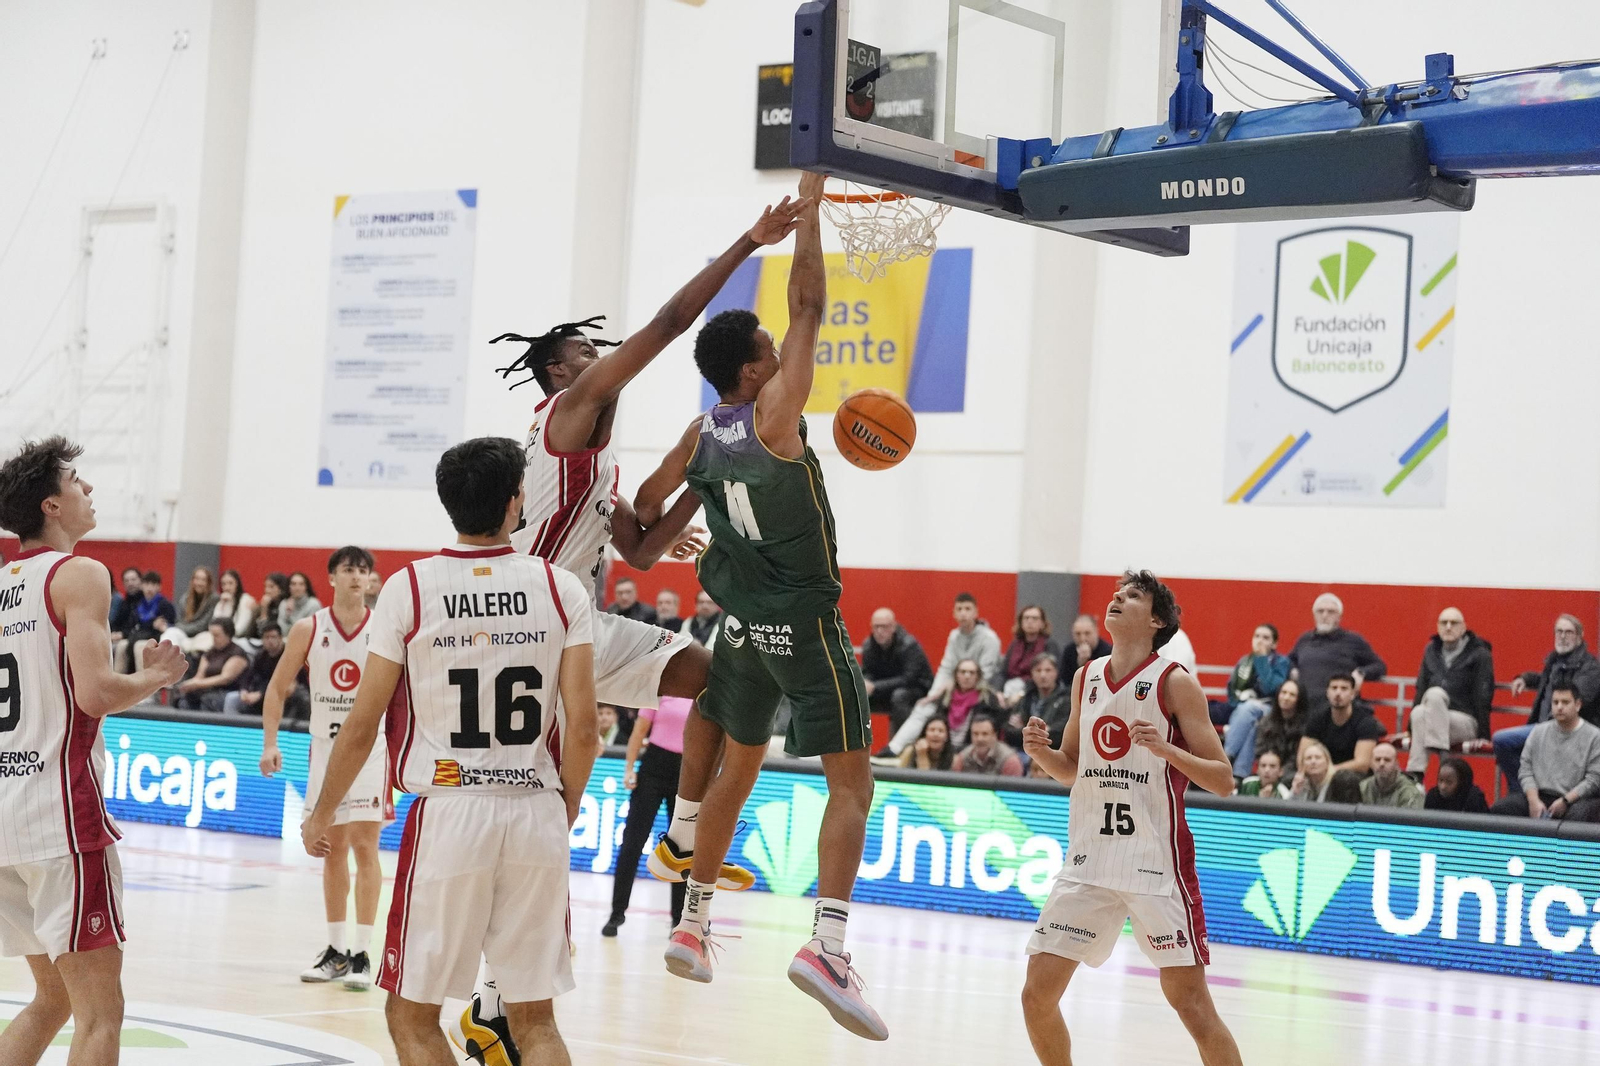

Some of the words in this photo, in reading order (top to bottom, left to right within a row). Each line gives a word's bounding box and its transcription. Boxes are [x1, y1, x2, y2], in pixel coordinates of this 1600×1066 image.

[762, 107, 792, 126] LOC
[1161, 177, 1245, 200] MONDO
[349, 214, 369, 226] LOS
[372, 212, 434, 224] PRINCIPIOS
[1293, 312, 1386, 334] Fundación
[815, 331, 896, 365] ante
[1306, 337, 1373, 358] Unicaja
[1291, 359, 1386, 374] Baloncesto
[851, 420, 899, 458] Wilson
[443, 591, 528, 619] VALERO
[433, 635, 456, 648] AIR
[461, 630, 547, 647] HORIZONT
[749, 631, 768, 643] DEL
[769, 634, 793, 646] SOL
[448, 666, 543, 749] 16
[461, 774, 483, 787] DE
[1081, 764, 1149, 784] asademont
[1099, 780, 1130, 790] ZARAGOZA
[1099, 803, 1135, 836] 15
[1049, 922, 1097, 939] azulmarino
